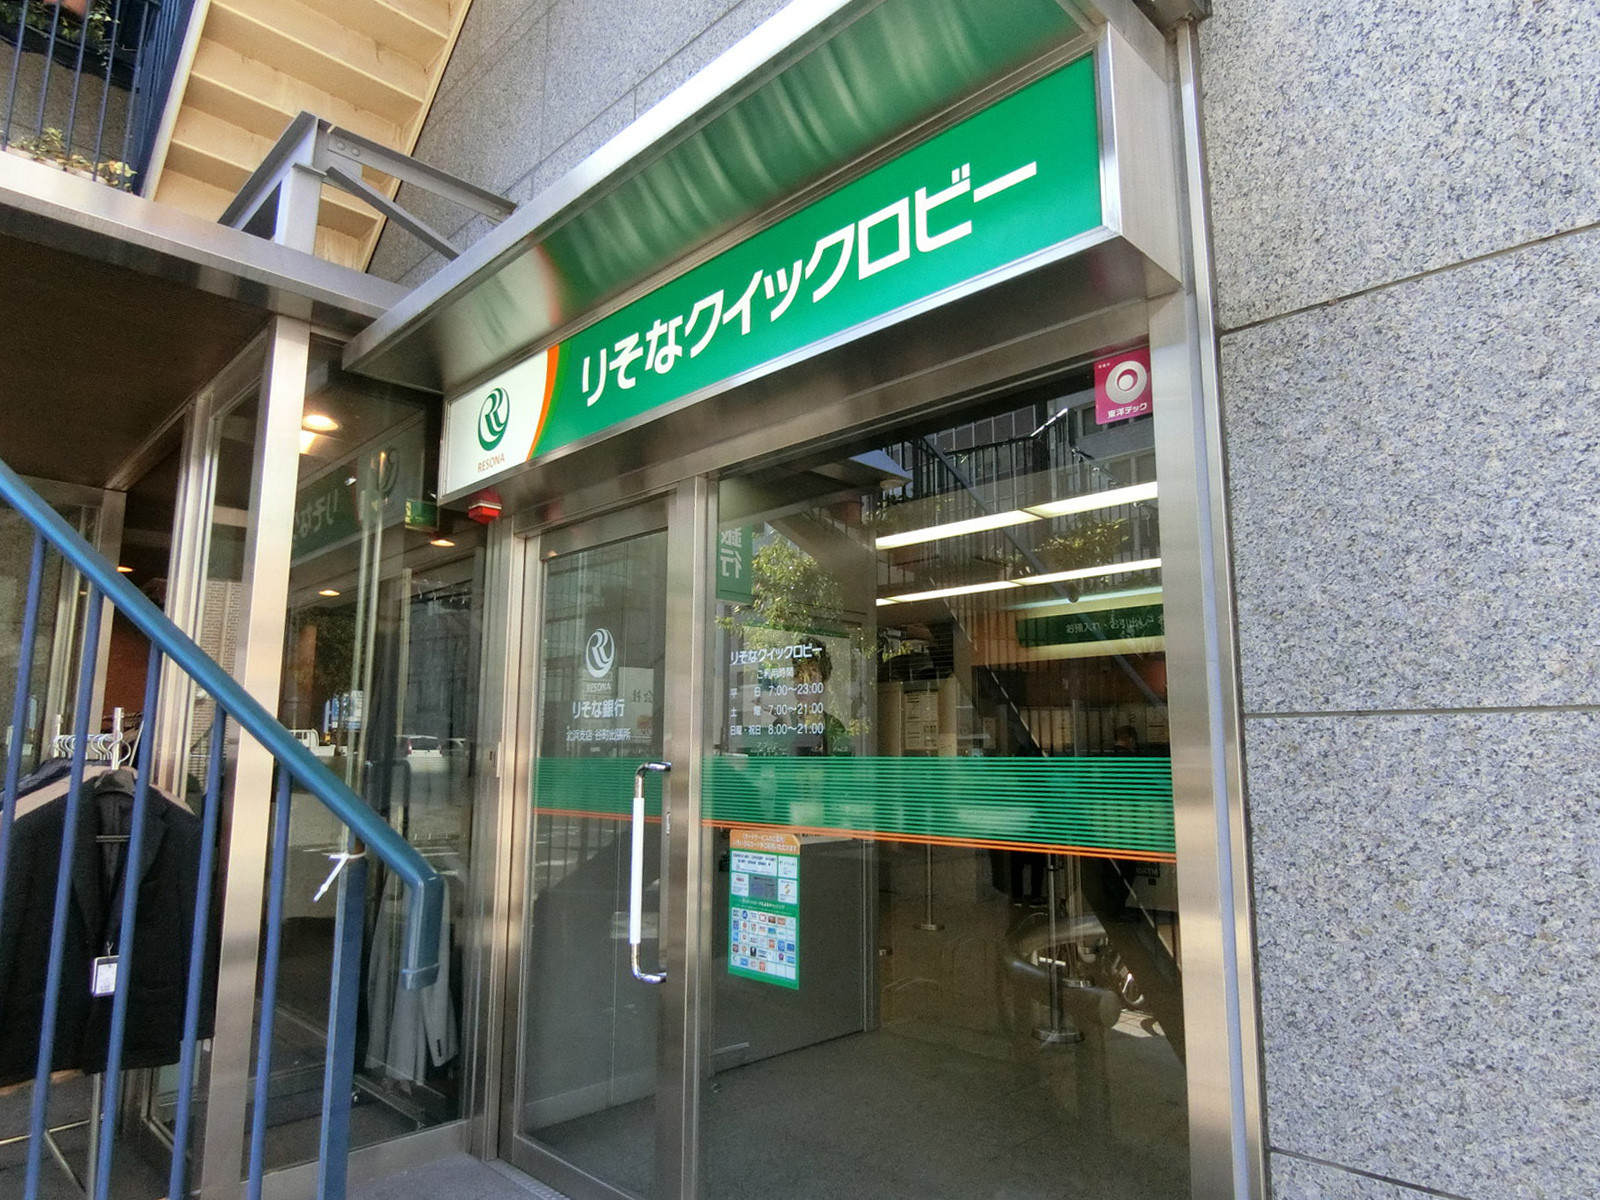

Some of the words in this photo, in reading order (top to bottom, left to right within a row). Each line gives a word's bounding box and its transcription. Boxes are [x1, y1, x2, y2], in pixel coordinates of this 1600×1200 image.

[582, 161, 1037, 407] りそなクイックロビー
[1107, 402, 1148, 419] 東洋テック
[478, 453, 505, 473] RESONA
[730, 643, 823, 665] りそなクイックロビー
[586, 682, 612, 694] RESONA
[572, 698, 626, 719] りそな銀行
